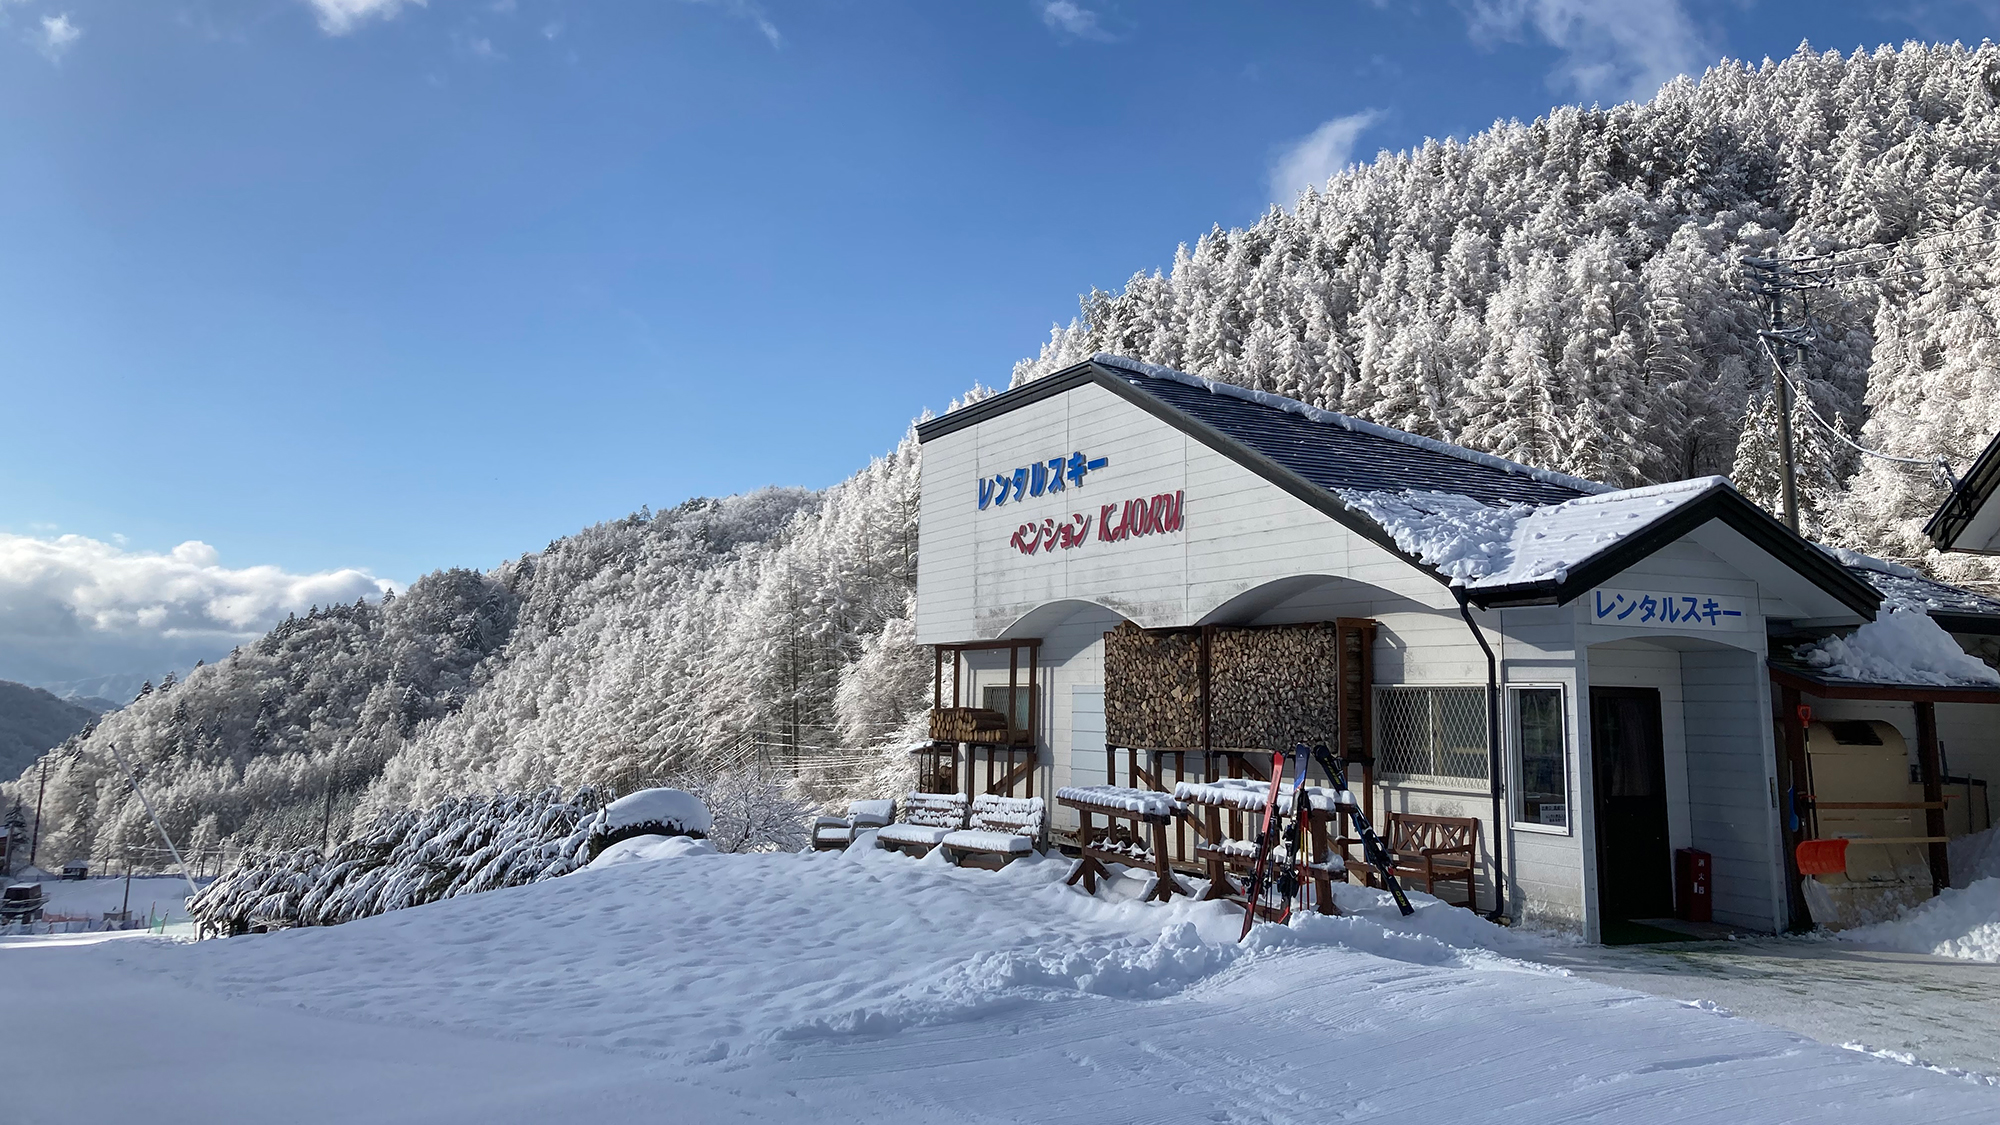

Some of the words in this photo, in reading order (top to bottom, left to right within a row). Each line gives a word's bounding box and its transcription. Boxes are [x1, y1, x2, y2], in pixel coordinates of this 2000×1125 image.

[978, 452, 1108, 510] レンタルスキー
[1010, 513, 1092, 556] ペンション
[1098, 490, 1184, 542] KAORU
[1596, 591, 1741, 625] レンタルスキー
